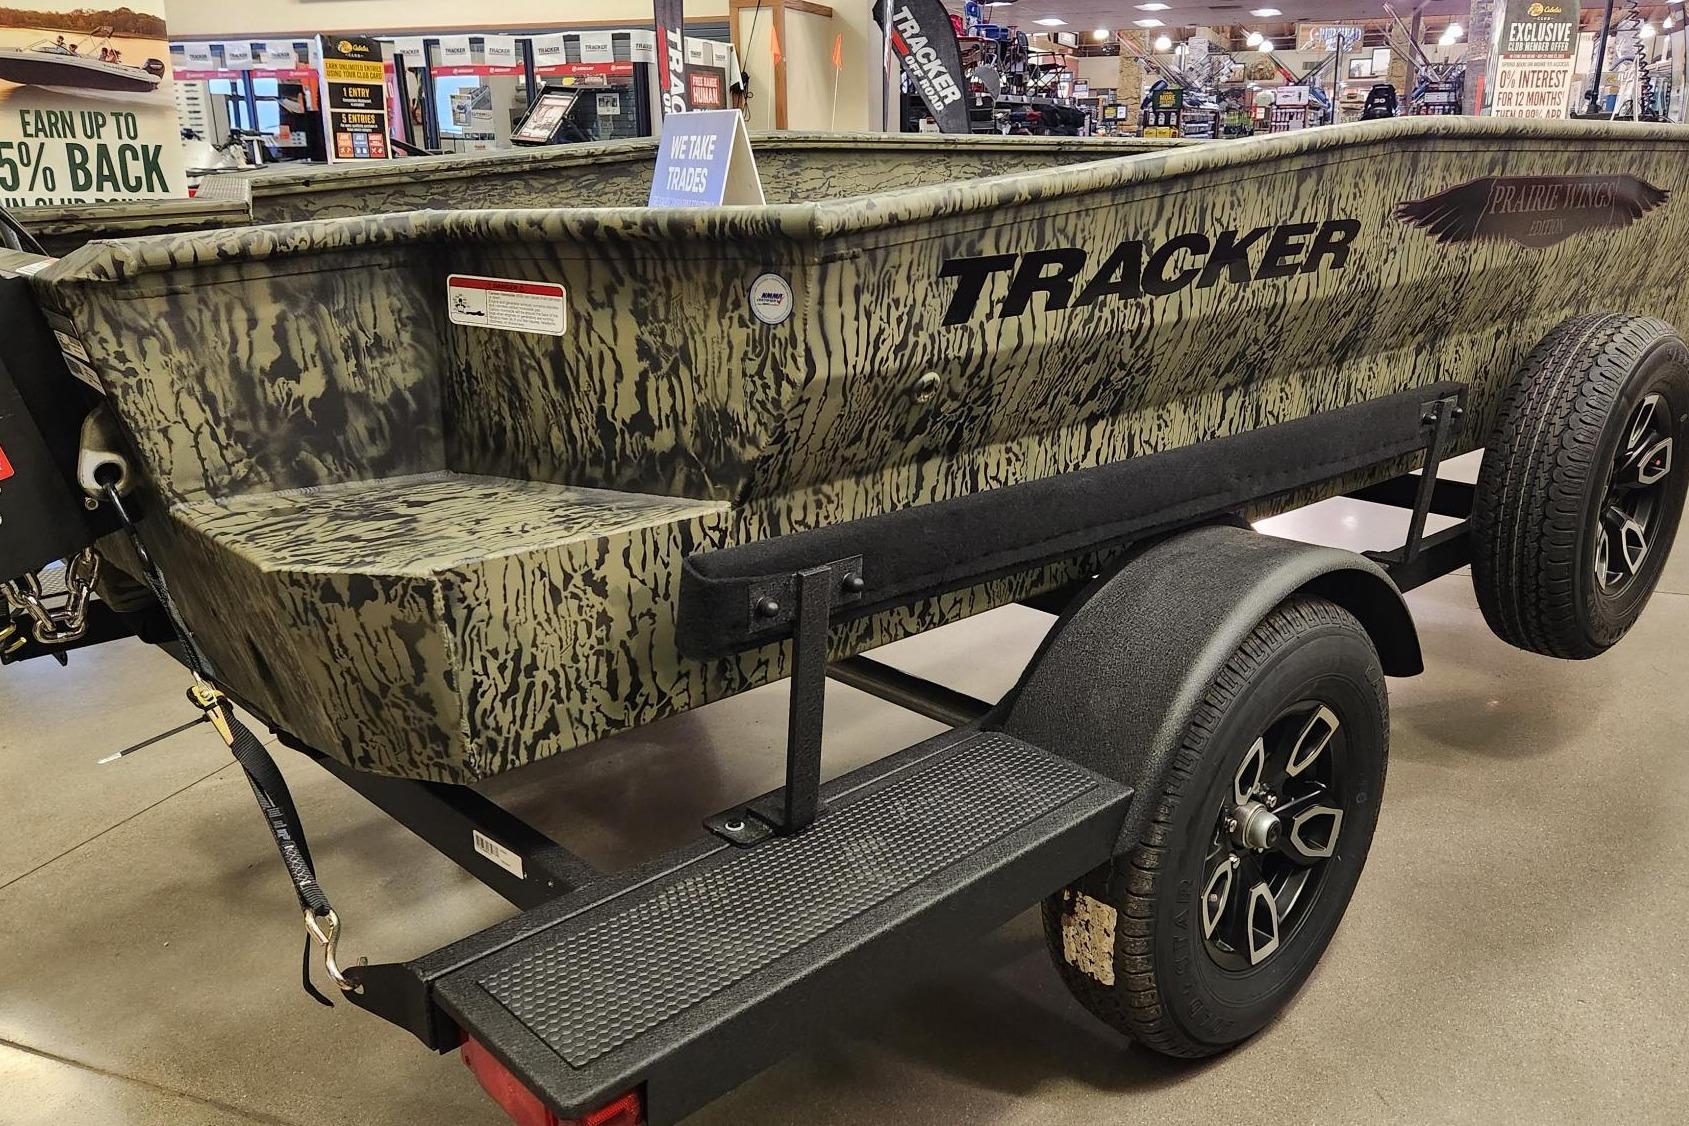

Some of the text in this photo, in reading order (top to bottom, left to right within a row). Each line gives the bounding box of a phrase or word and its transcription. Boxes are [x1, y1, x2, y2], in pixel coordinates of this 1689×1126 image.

[1509, 22, 1572, 42] EXCLUSIVE
[892, 5, 962, 106] TRACKER
[1507, 42, 1569, 52] CLUB MEMBER OFFER
[667, 27, 687, 114] TRAC
[904, 55, 945, 111] OFF ROAD
[1500, 69, 1568, 89] 0% INTEREST
[343, 87, 370, 98] 1 ENTRY
[1497, 91, 1513, 107] FOR
[1515, 91, 1525, 107] 12
[19, 109, 138, 141] EARN UP TO
[342, 113, 376, 124] 5 ENTRIES
[670, 134, 717, 161] WE TAKE
[0, 141, 170, 193] 5% BACK
[666, 166, 708, 193] TRADES
[1489, 181, 1616, 215] PRAIRIE WINGS
[936, 218, 1362, 327] TRACKER
